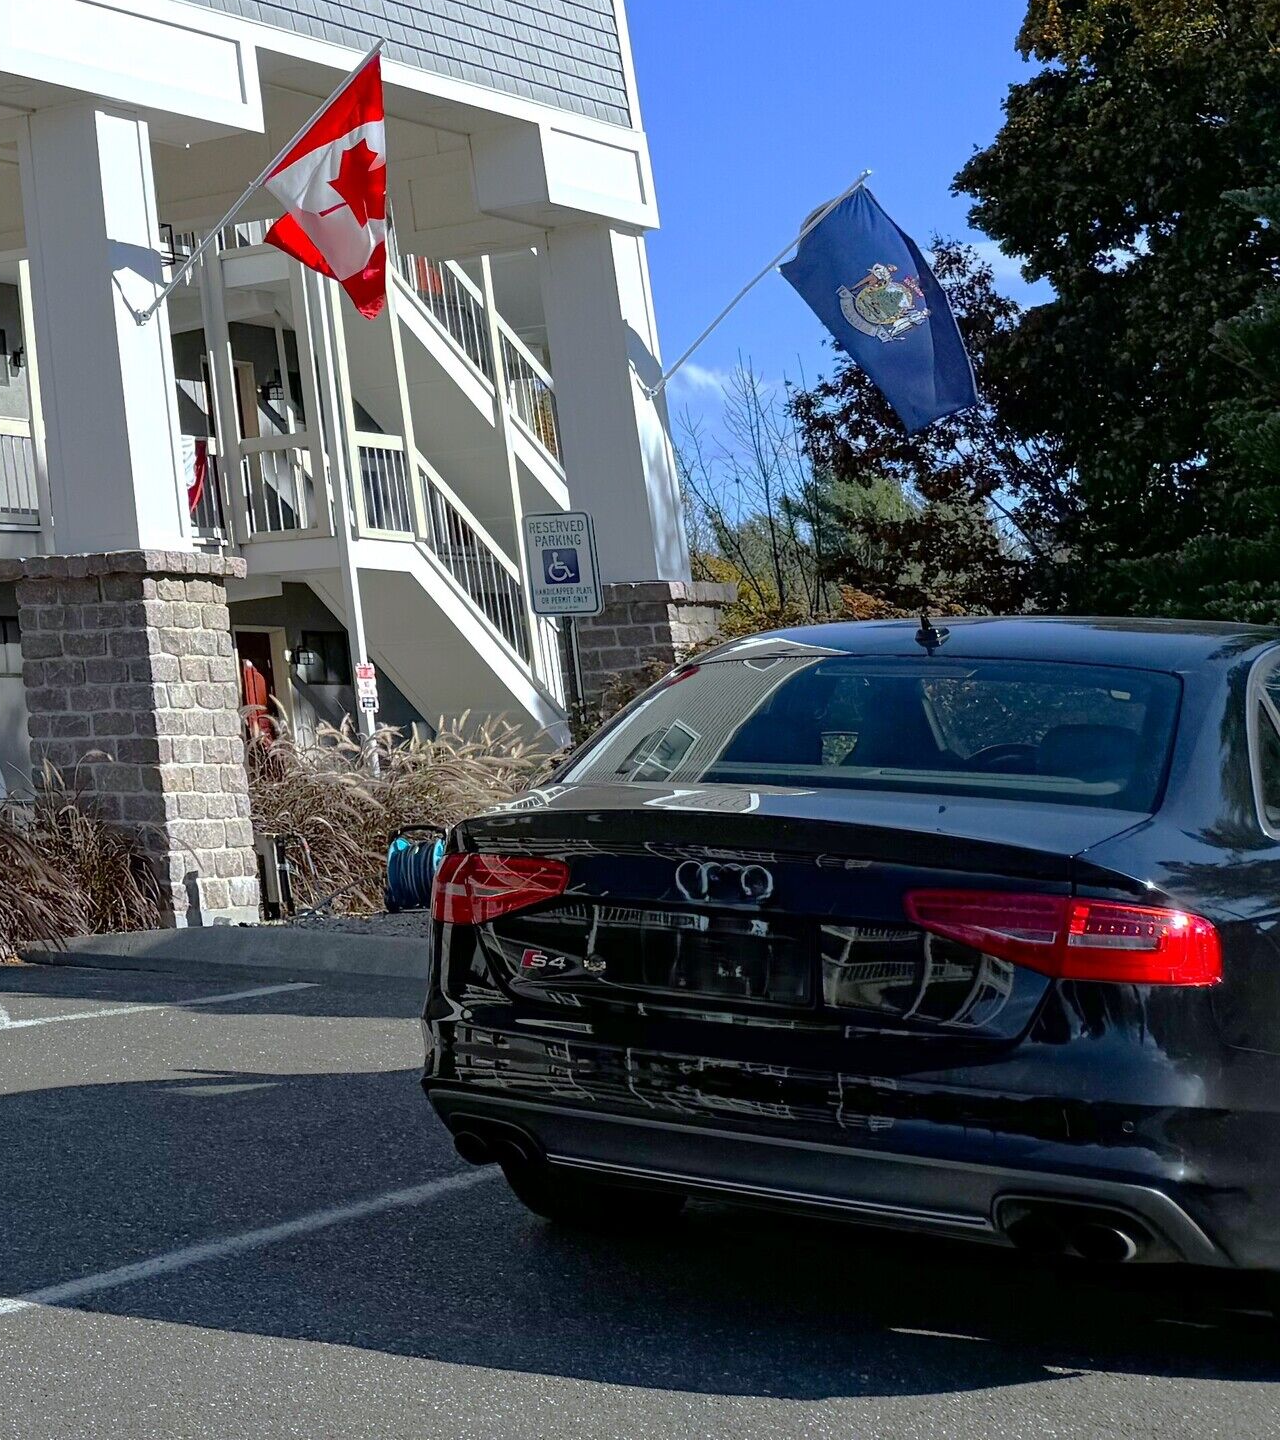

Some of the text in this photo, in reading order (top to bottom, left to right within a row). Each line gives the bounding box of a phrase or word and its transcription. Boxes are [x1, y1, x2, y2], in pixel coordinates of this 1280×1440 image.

[528, 520, 584, 534] RESERVED
[535, 534, 582, 547] PARKING
[535, 586, 593, 595] HANDICAPPED PLATE
[551, 596, 571, 604] PERMIT
[573, 595, 588, 603] ONLY
[530, 954, 567, 970] S4
